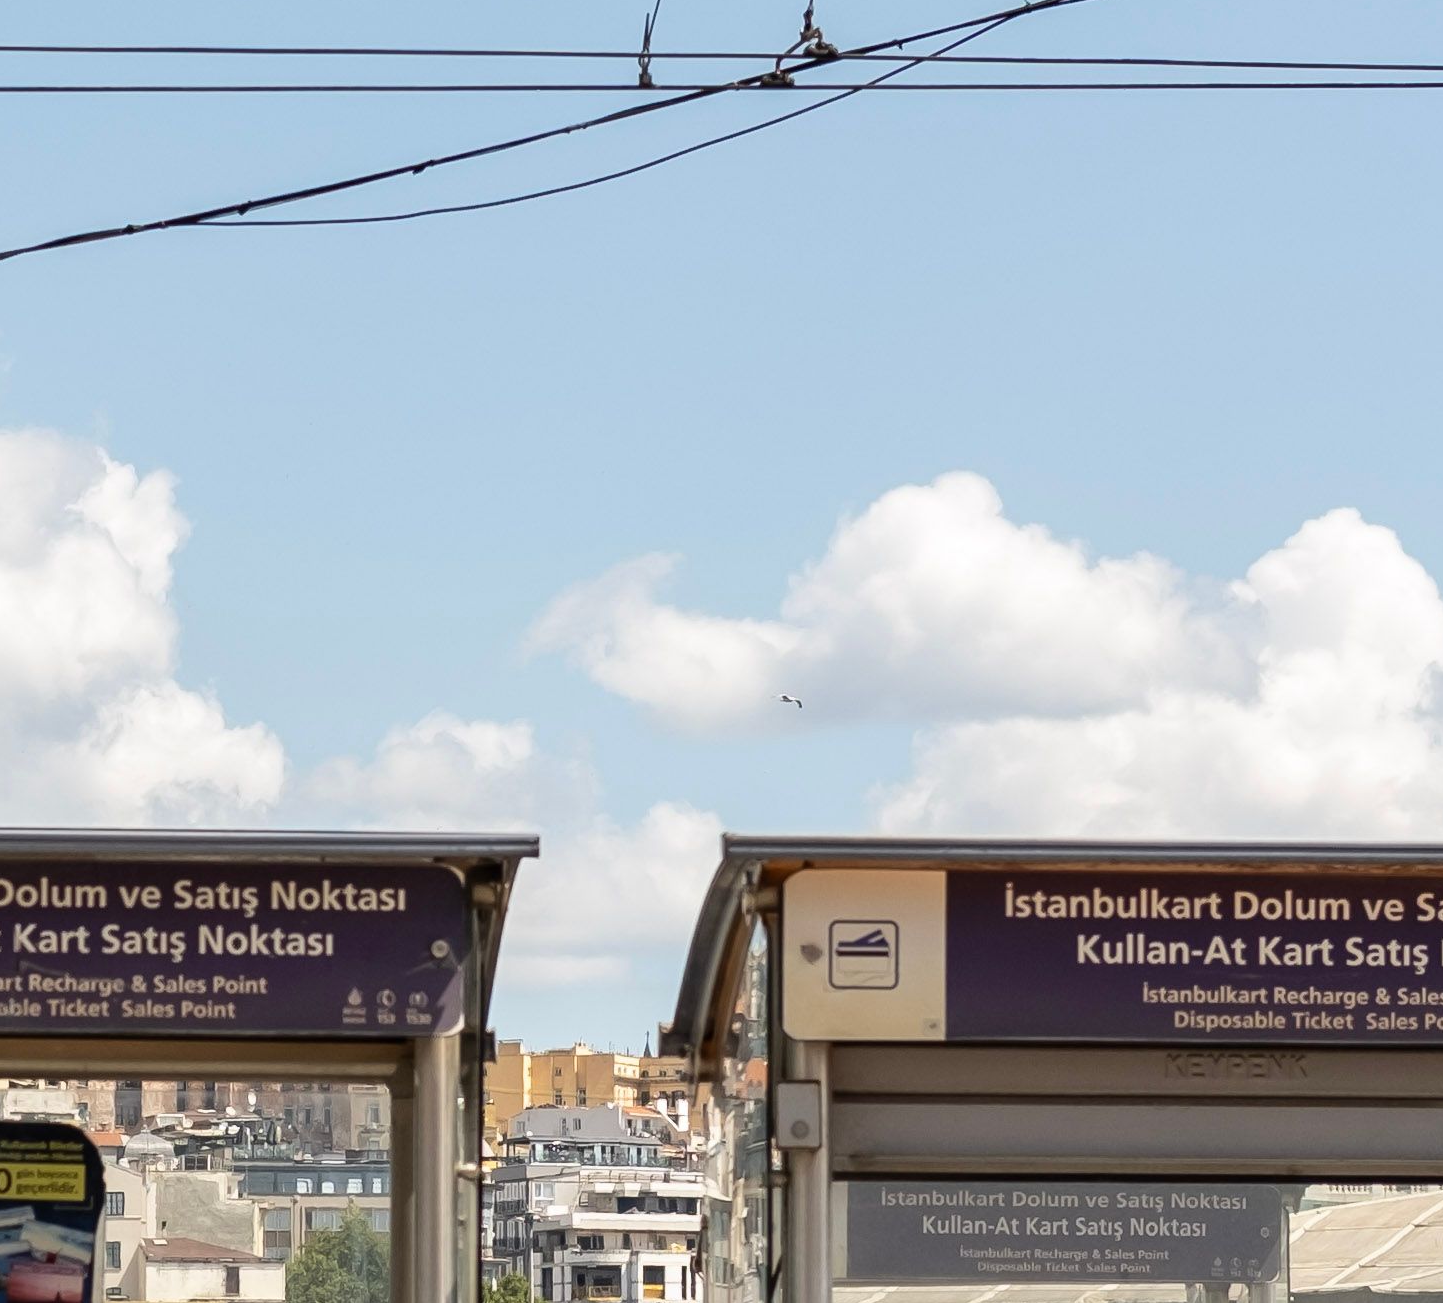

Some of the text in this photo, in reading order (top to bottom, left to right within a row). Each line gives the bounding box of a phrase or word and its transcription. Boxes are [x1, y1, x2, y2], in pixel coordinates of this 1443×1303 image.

[119, 885, 162, 909] ve
[173, 879, 259, 917] Satış
[271, 879, 406, 911] Noktası
[1005, 881, 1221, 920] İstanbulkart
[1233, 890, 1350, 921] Dolum
[1362, 898, 1404, 921] ve
[13, 923, 90, 954] Kart
[101, 924, 186, 963] Satış
[198, 924, 334, 956] Noktası
[1077, 933, 1246, 966] Kullan-At
[1259, 936, 1334, 966] Kart
[1345, 937, 1429, 975] Satış
[28, 973, 124, 997] Recharge
[131, 975, 146, 993] &
[153, 974, 206, 994] Sales
[213, 975, 268, 994] Point
[1143, 981, 1268, 1005] İstanbulkart
[1273, 986, 1369, 1009] Recharge
[1375, 988, 1390, 1005] &
[47, 999, 110, 1018] Ticket
[122, 1000, 174, 1019] Sales
[181, 1000, 236, 1019] Point
[1174, 1010, 1285, 1032] Disposable
[1291, 1011, 1354, 1030] Ticket
[1366, 1012, 1418, 1031] Sales
[881, 1187, 1247, 1212] İstanbulkart Dolum ve Satış Noktası
[923, 1215, 1207, 1241] Kullan-At Kart Satış Noktası
[960, 1245, 1169, 1262] İstanbulkart Recharge & Sales Point
[978, 1262, 1151, 1274] Disposable Ticket Sales Point
